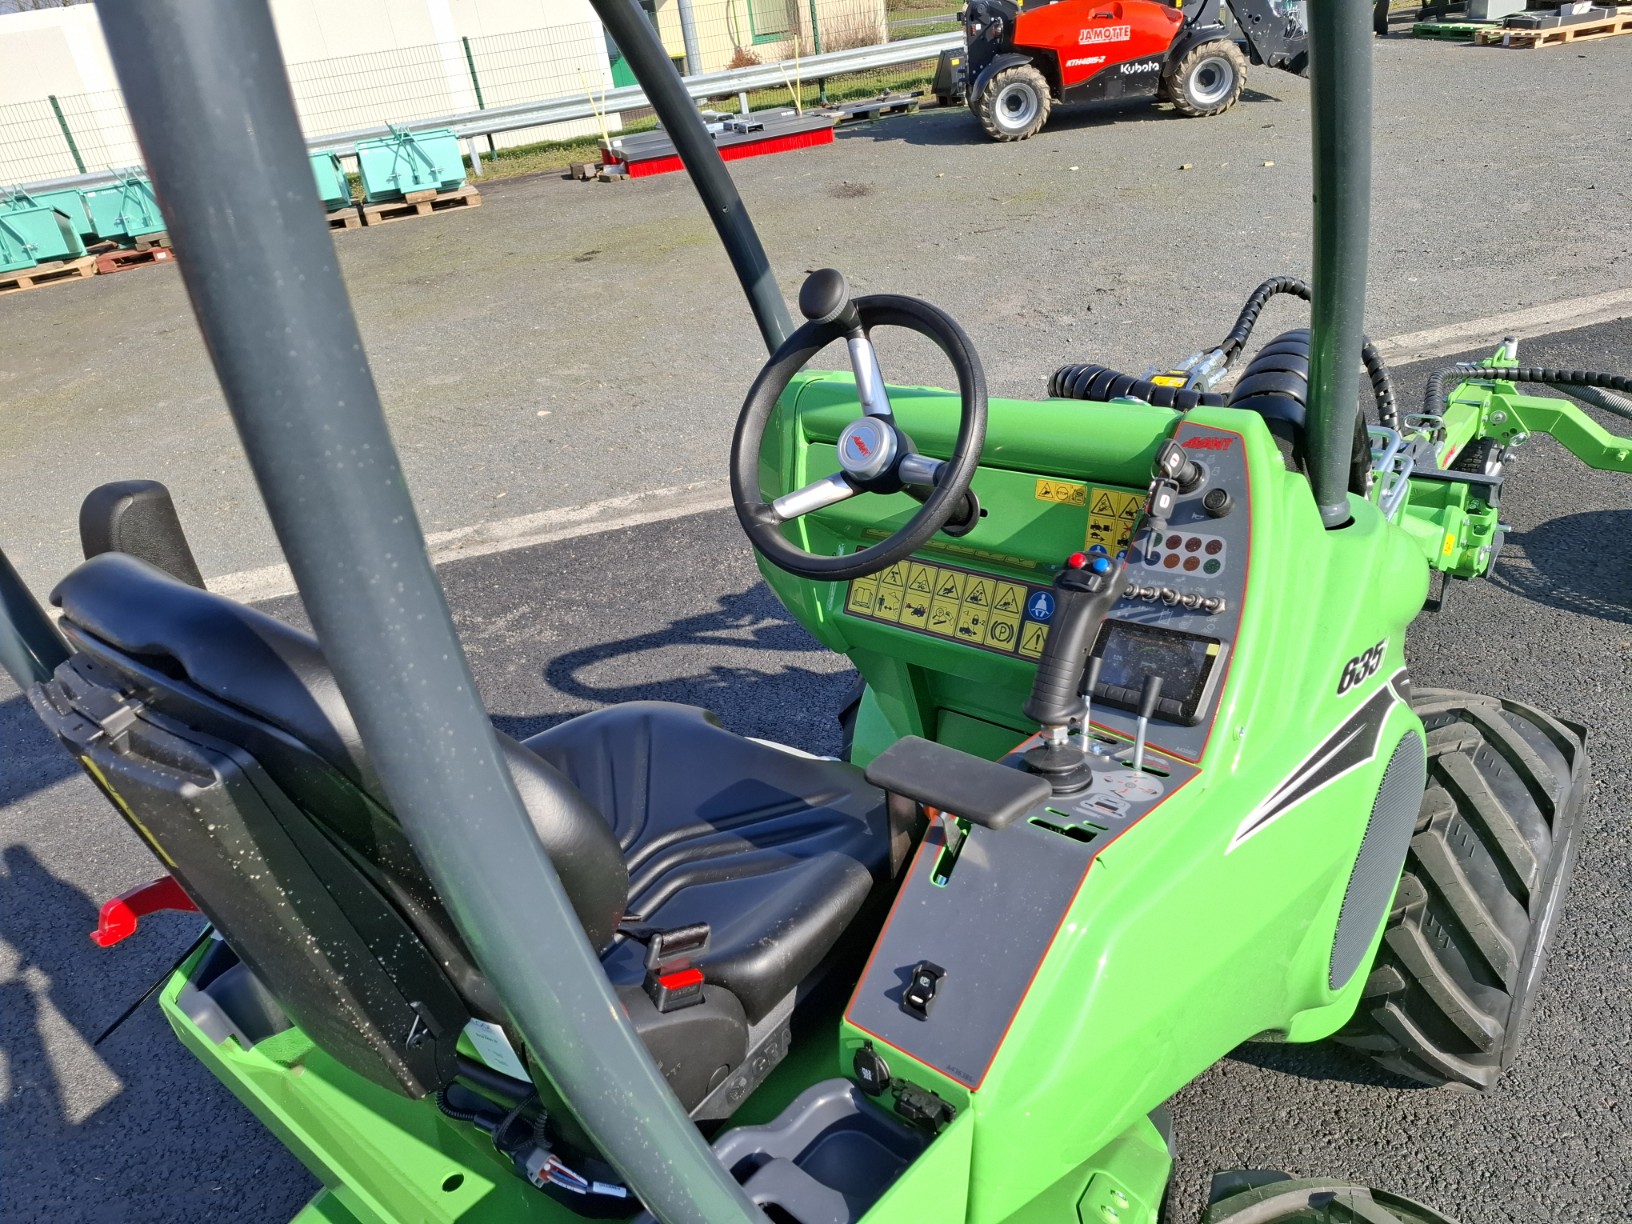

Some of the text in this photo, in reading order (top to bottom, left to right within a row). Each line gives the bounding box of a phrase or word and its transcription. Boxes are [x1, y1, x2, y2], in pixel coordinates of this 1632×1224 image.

[1078, 26, 1130, 42] JAMOTTE
[1121, 60, 1160, 74] Kubota
[1336, 637, 1386, 695] 635
